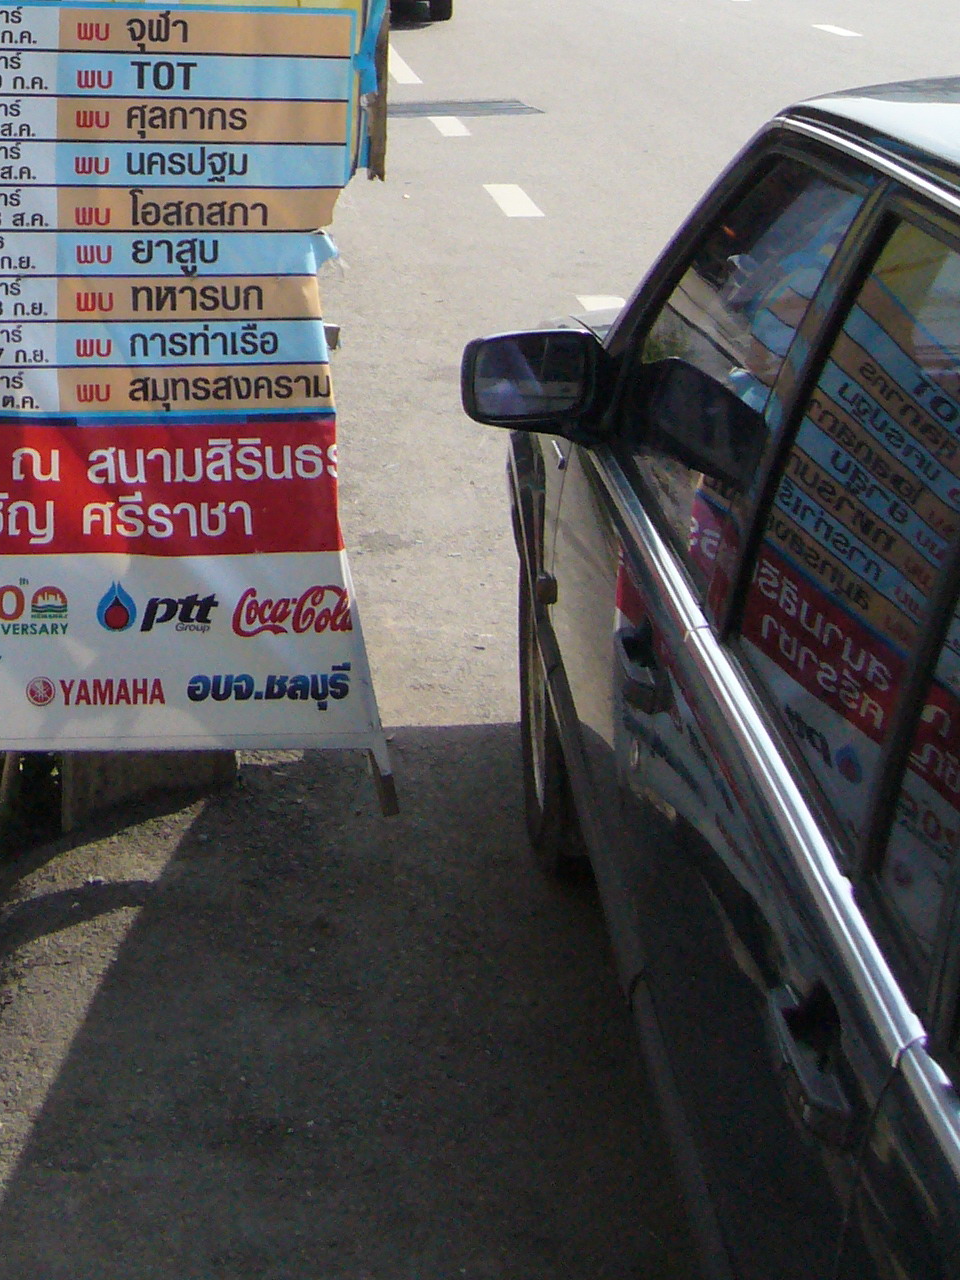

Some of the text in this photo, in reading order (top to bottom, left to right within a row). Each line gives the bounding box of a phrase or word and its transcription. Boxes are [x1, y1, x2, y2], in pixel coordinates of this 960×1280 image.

[1, 29, 38, 45] ก.ค.
[77, 11, 189, 53] พบ จุฬา
[12, 75, 49, 91] ก.ค.
[76, 61, 198, 91] พบ TOT
[0, 120, 36, 138] ส.ค.
[75, 104, 247, 139] พบ ศุลกากร
[0, 163, 37, 180] ส.ค.
[74, 147, 248, 182] พบ นครปฐม
[12, 211, 49, 228] ส.ค.
[75, 190, 269, 227] พบ โอสถสภา
[0, 254, 36, 270] ก.ย.
[76, 239, 219, 277] พบ ยาสูบ
[13, 300, 48, 317] ก.ย.
[76, 284, 263, 312] พบ ทหารบก
[76, 324, 279, 357] พบ การท่าเรือ
[14, 348, 49, 364] ก.ย.
[2, 393, 40, 409] ต.ค.
[76, 372, 330, 412] พบ สมุทรสงคราม
[12, 447, 61, 482] ณ
[82, 491, 253, 539] ศรีราชา
[140, 593, 219, 632] ptt
[232, 585, 352, 638] Coca-Cola
[175, 623, 211, 634] Group
[59, 677, 166, 706] YAMAHA
[186, 662, 351, 711] อบจ.ชลบุรี
